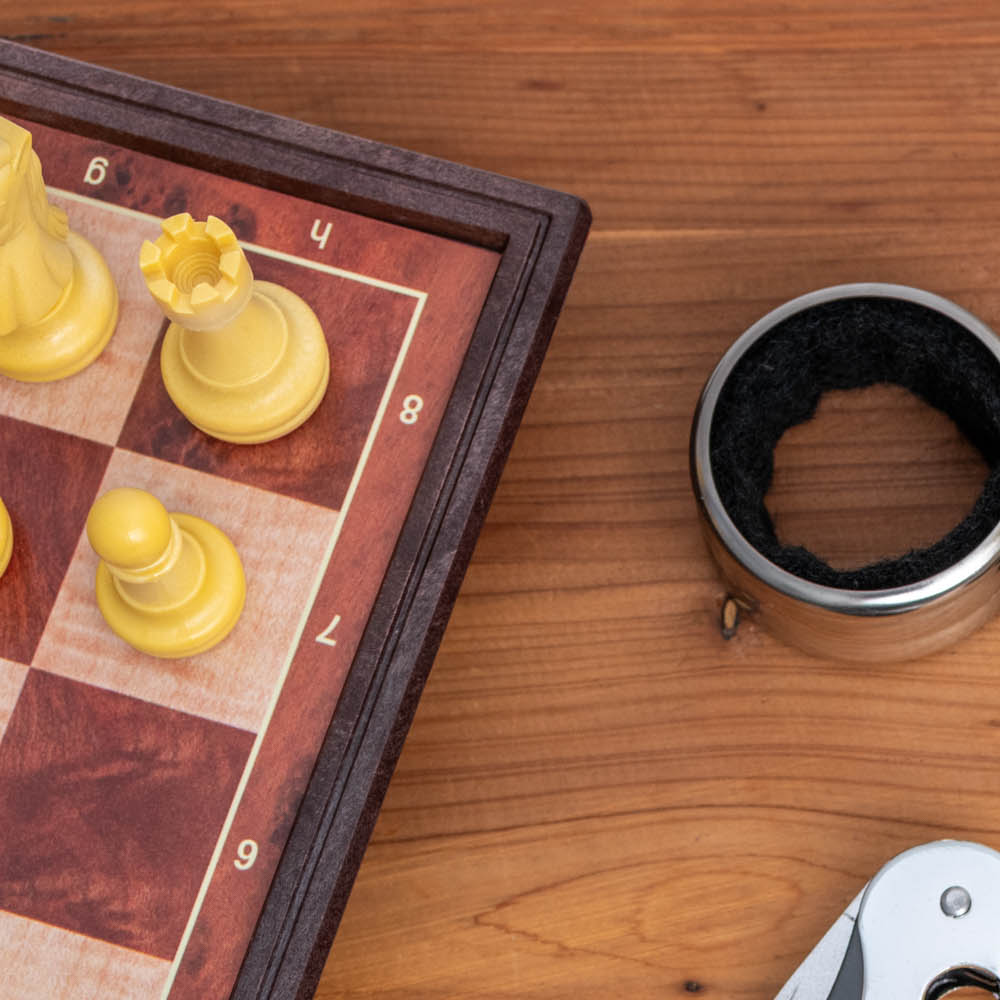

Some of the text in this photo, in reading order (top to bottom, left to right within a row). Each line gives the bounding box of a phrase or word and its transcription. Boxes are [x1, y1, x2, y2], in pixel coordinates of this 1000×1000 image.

[399, 394, 424, 425] 8
[315, 614, 341, 647] 7
[233, 839, 259, 871] 6
